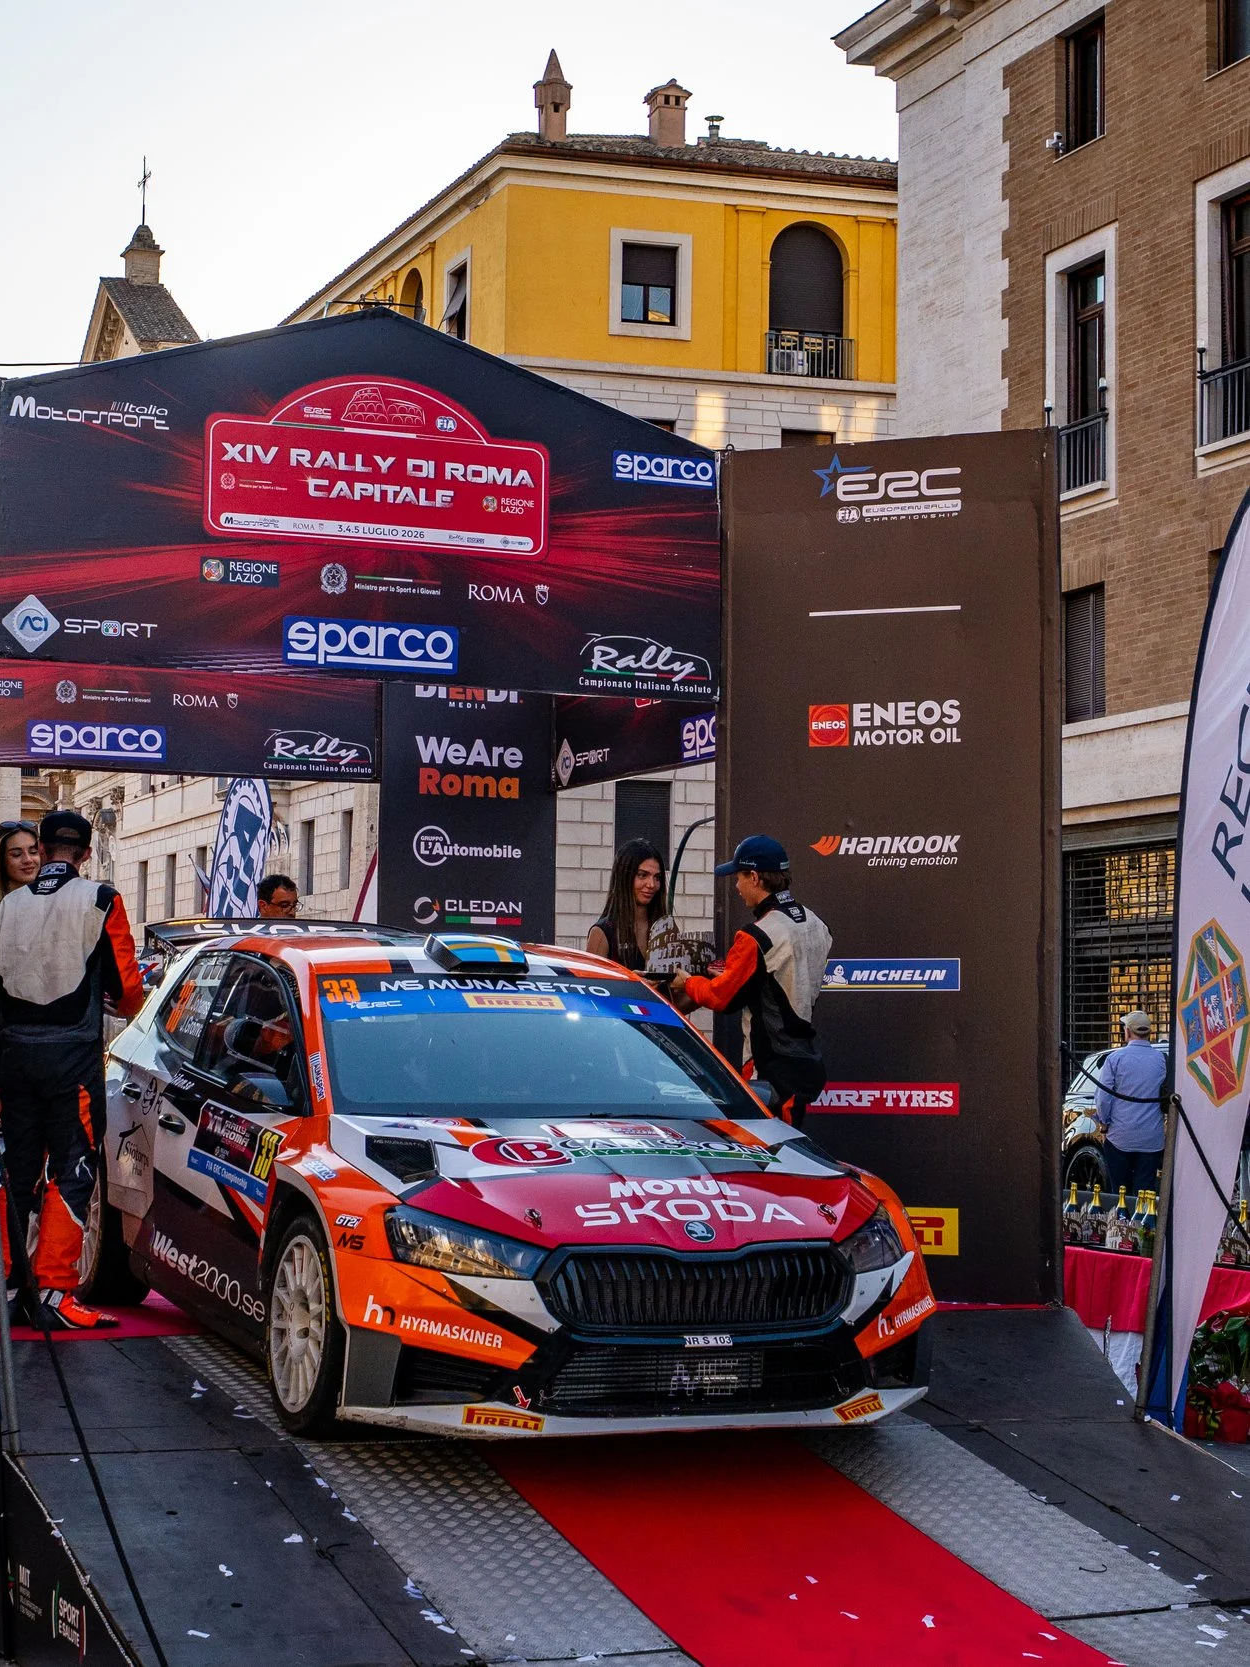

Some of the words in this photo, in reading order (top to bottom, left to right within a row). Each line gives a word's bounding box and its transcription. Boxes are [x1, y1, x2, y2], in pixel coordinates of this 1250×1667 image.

[9, 395, 169, 430] Motorsport
[125, 402, 167, 416] Italia
[221, 442, 279, 464] XIV
[289, 448, 396, 473] RALLY
[407, 458, 435, 479] DI
[445, 462, 535, 488] ROMA
[616, 453, 713, 481] sparco
[308, 478, 454, 508] CAPITALE
[836, 467, 961, 501] ERC
[501, 497, 535, 508] REGIONE
[501, 505, 524, 514] LAZIO
[865, 505, 918, 514] EUROPEAN
[923, 502, 958, 510] RALLY
[865, 512, 959, 522] CHAMPIONSHIP
[292, 523, 315, 531] ROMA
[337, 524, 359, 534] 3.4.5
[363, 526, 399, 537] LUGLIO
[401, 529, 425, 539] 2026
[229, 561, 278, 574] REGIONE
[229, 572, 263, 584] LAZIO
[354, 583, 378, 592] Ministro
[378, 585, 388, 593] per
[396, 585, 411, 594] Sport
[420, 586, 441, 596] Giovani
[468, 584, 525, 603] ROMA
[18, 615, 48, 632] ACI
[64, 618, 158, 639] SPORT
[288, 621, 454, 664] sparco
[591, 645, 696, 682] Rally
[579, 677, 632, 689] Campionato
[635, 680, 671, 691] Italiano
[674, 683, 712, 694] Assoluto
[173, 693, 218, 708] ROMA
[853, 700, 961, 726] ENEOS
[812, 720, 846, 731] ENEOS
[31, 723, 163, 756] sparco
[853, 728, 924, 746] MOTOR
[930, 727, 961, 743] OIL
[273, 738, 359, 765] Rally
[415, 736, 523, 768] WeAre
[575, 748, 610, 767] SPORT
[263, 761, 306, 771] Campionato
[309, 763, 338, 773] Italiano
[341, 765, 372, 774] Assoluto
[419, 767, 519, 799] Roma
[420, 841, 521, 858] L'Automobile
[867, 855, 907, 868] driving
[910, 855, 958, 866] emotion
[445, 900, 522, 914] CLEDAN
[851, 969, 946, 982] MICHELIN
[323, 979, 362, 1003] 33
[380, 979, 424, 992] MS
[428, 980, 610, 997] MUNARETTO
[473, 995, 555, 1008] PIRELLI
[811, 1090, 882, 1107] MRF
[884, 1090, 953, 1108] TYRES
[253, 1131, 279, 1180] 33
[609, 1179, 740, 1199] MOTUL
[337, 1232, 366, 1250] MS
[153, 1231, 266, 1323] West2000.se
[894, 1294, 935, 1330] HYRMASKINER
[400, 1313, 503, 1349] HYRMASKINER
[685, 1337, 700, 1345] NR
[714, 1336, 732, 1345] 103
[837, 1395, 883, 1422] PIRELLI
[467, 1408, 541, 1431] PIRELLI
[58, 1597, 80, 1629] SPORT
